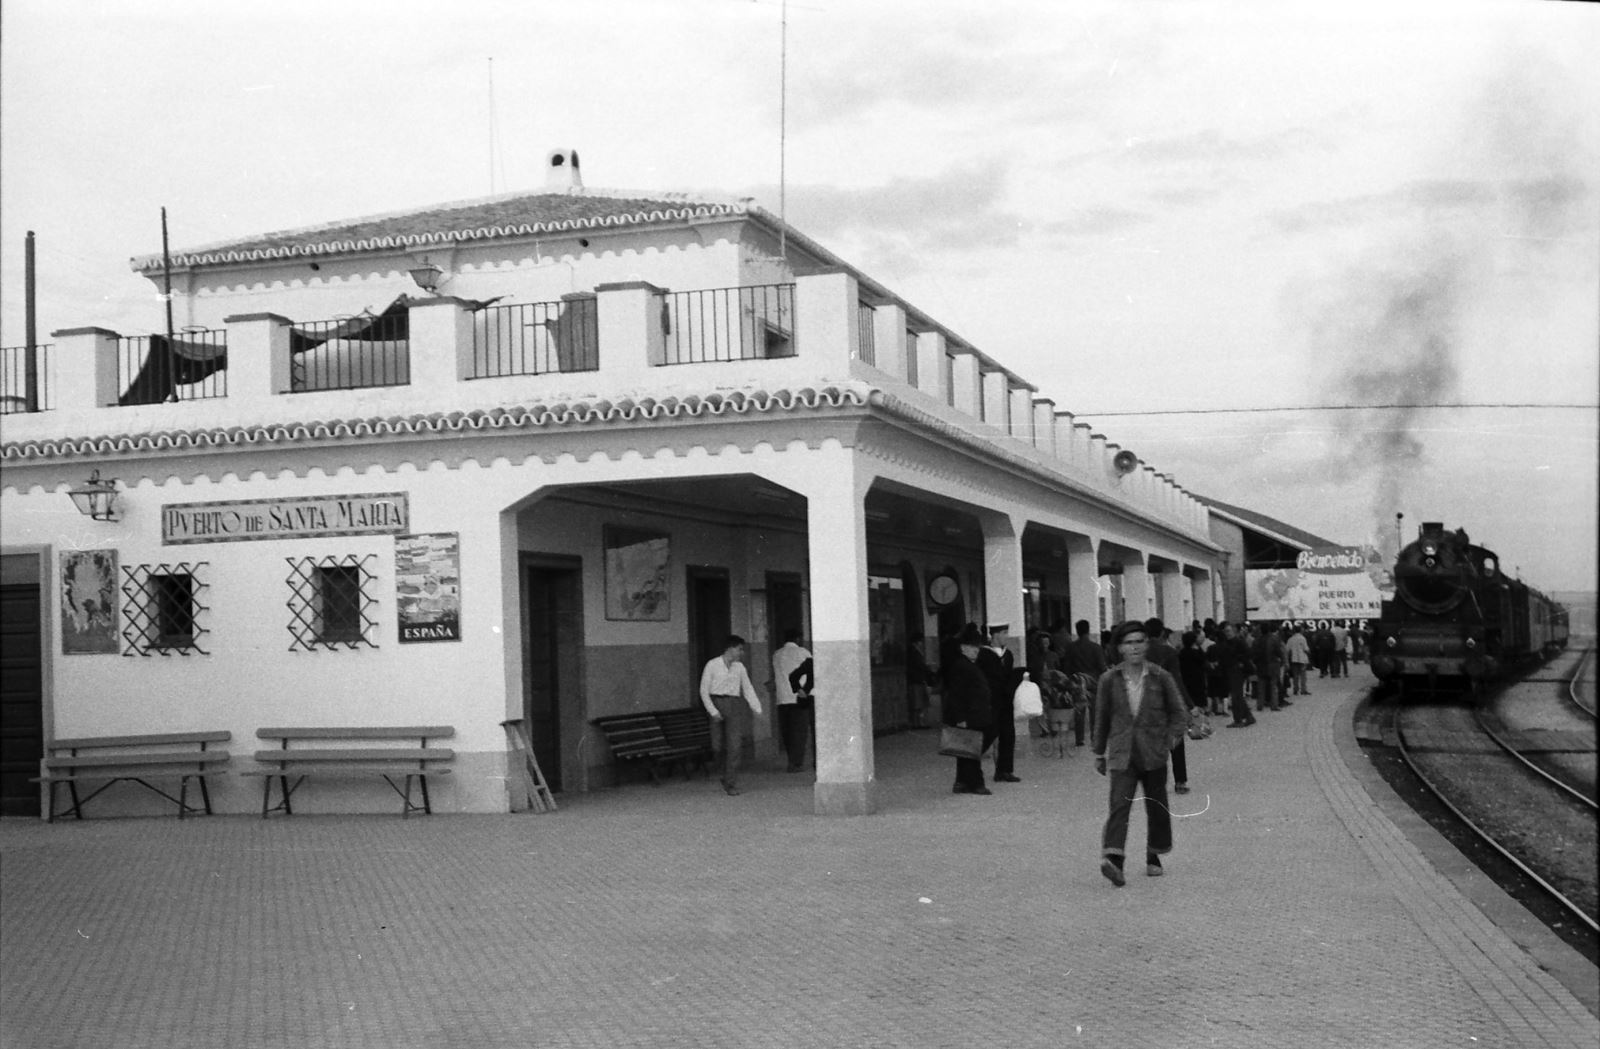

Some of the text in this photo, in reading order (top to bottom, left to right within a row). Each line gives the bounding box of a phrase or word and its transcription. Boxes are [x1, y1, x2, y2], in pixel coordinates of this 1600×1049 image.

[269, 505, 328, 531] SANTA
[336, 501, 403, 528] MARIA
[1318, 590, 1355, 599] PUERTO
[1319, 602, 1330, 610] DE
[1336, 601, 1364, 610] SANTA
[404, 624, 454, 639] ESPAÑA
